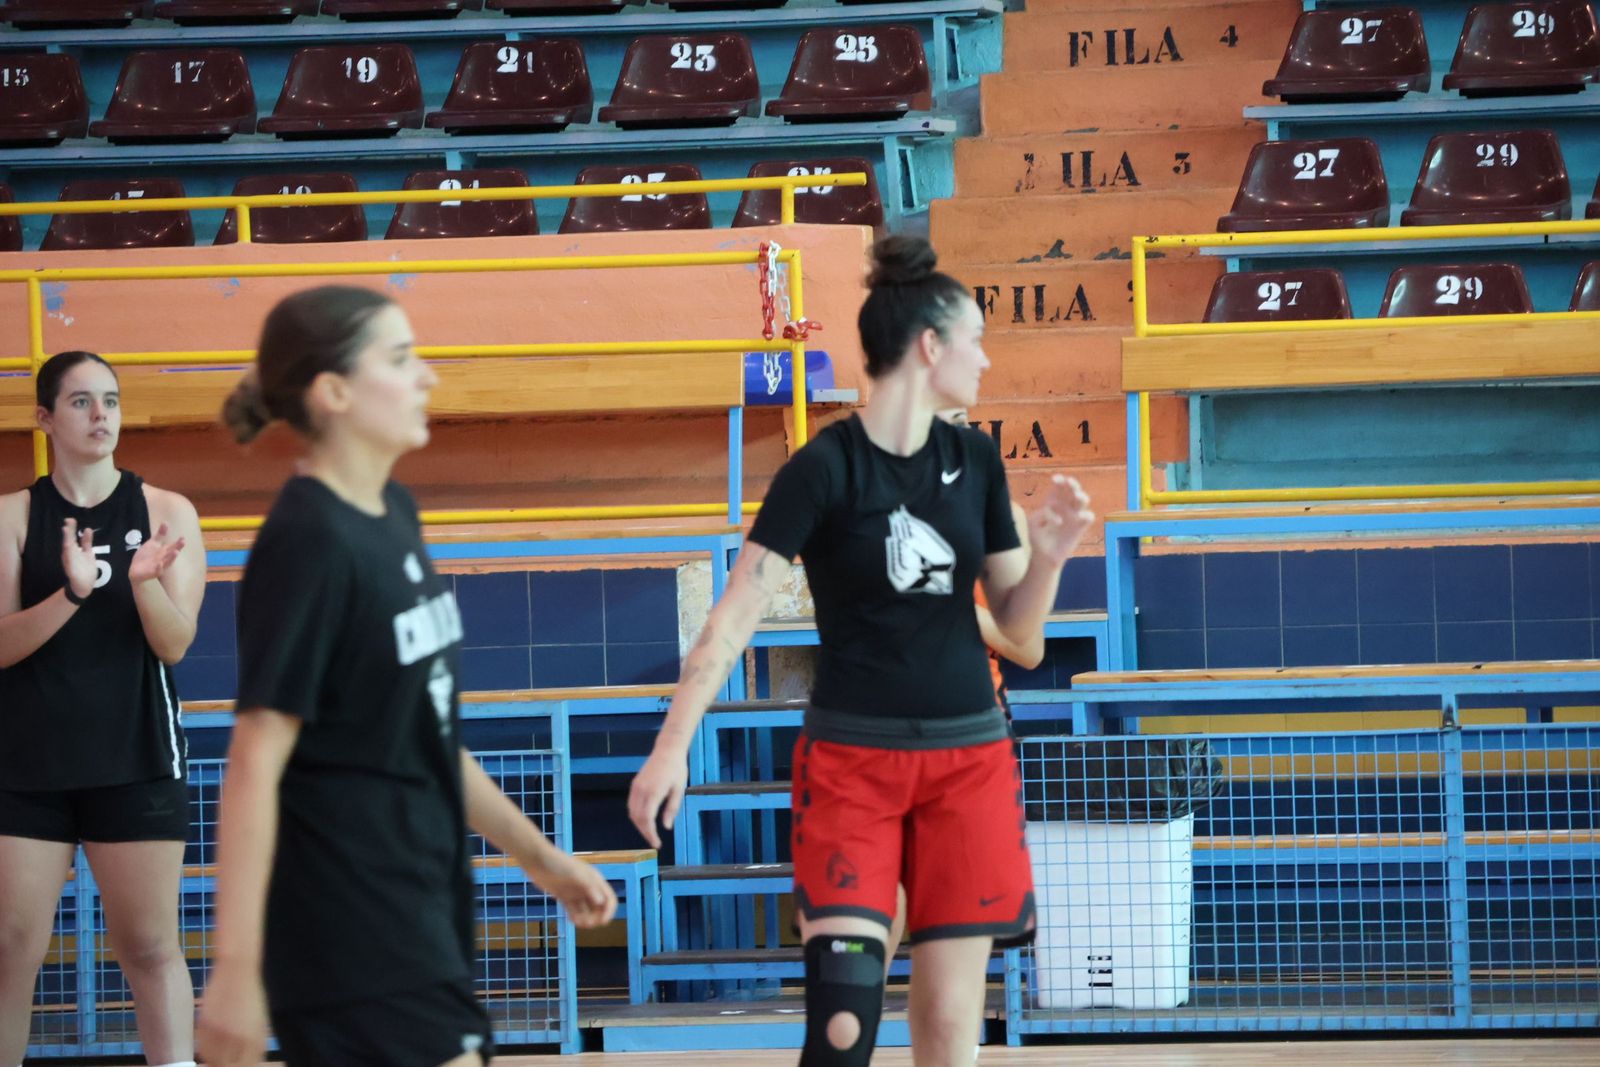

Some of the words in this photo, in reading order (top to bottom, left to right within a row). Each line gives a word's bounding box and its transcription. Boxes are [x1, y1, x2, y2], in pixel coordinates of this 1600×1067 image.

[1340, 17, 1382, 45] 27
[1512, 10, 1555, 37] 29
[496, 46, 534, 73] 21
[670, 42, 716, 72] 23
[835, 34, 878, 63] 25
[1069, 26, 1184, 67] FILA
[1220, 25, 1238, 47] 4
[171, 61, 204, 84] 17
[344, 56, 378, 83] 19
[1293, 149, 1340, 180] 27
[1476, 143, 1519, 167] 29
[973, 283, 1097, 323] FILA
[1257, 281, 1303, 311] 27
[1435, 275, 1484, 305] 29
[1078, 420, 1091, 444] 1
